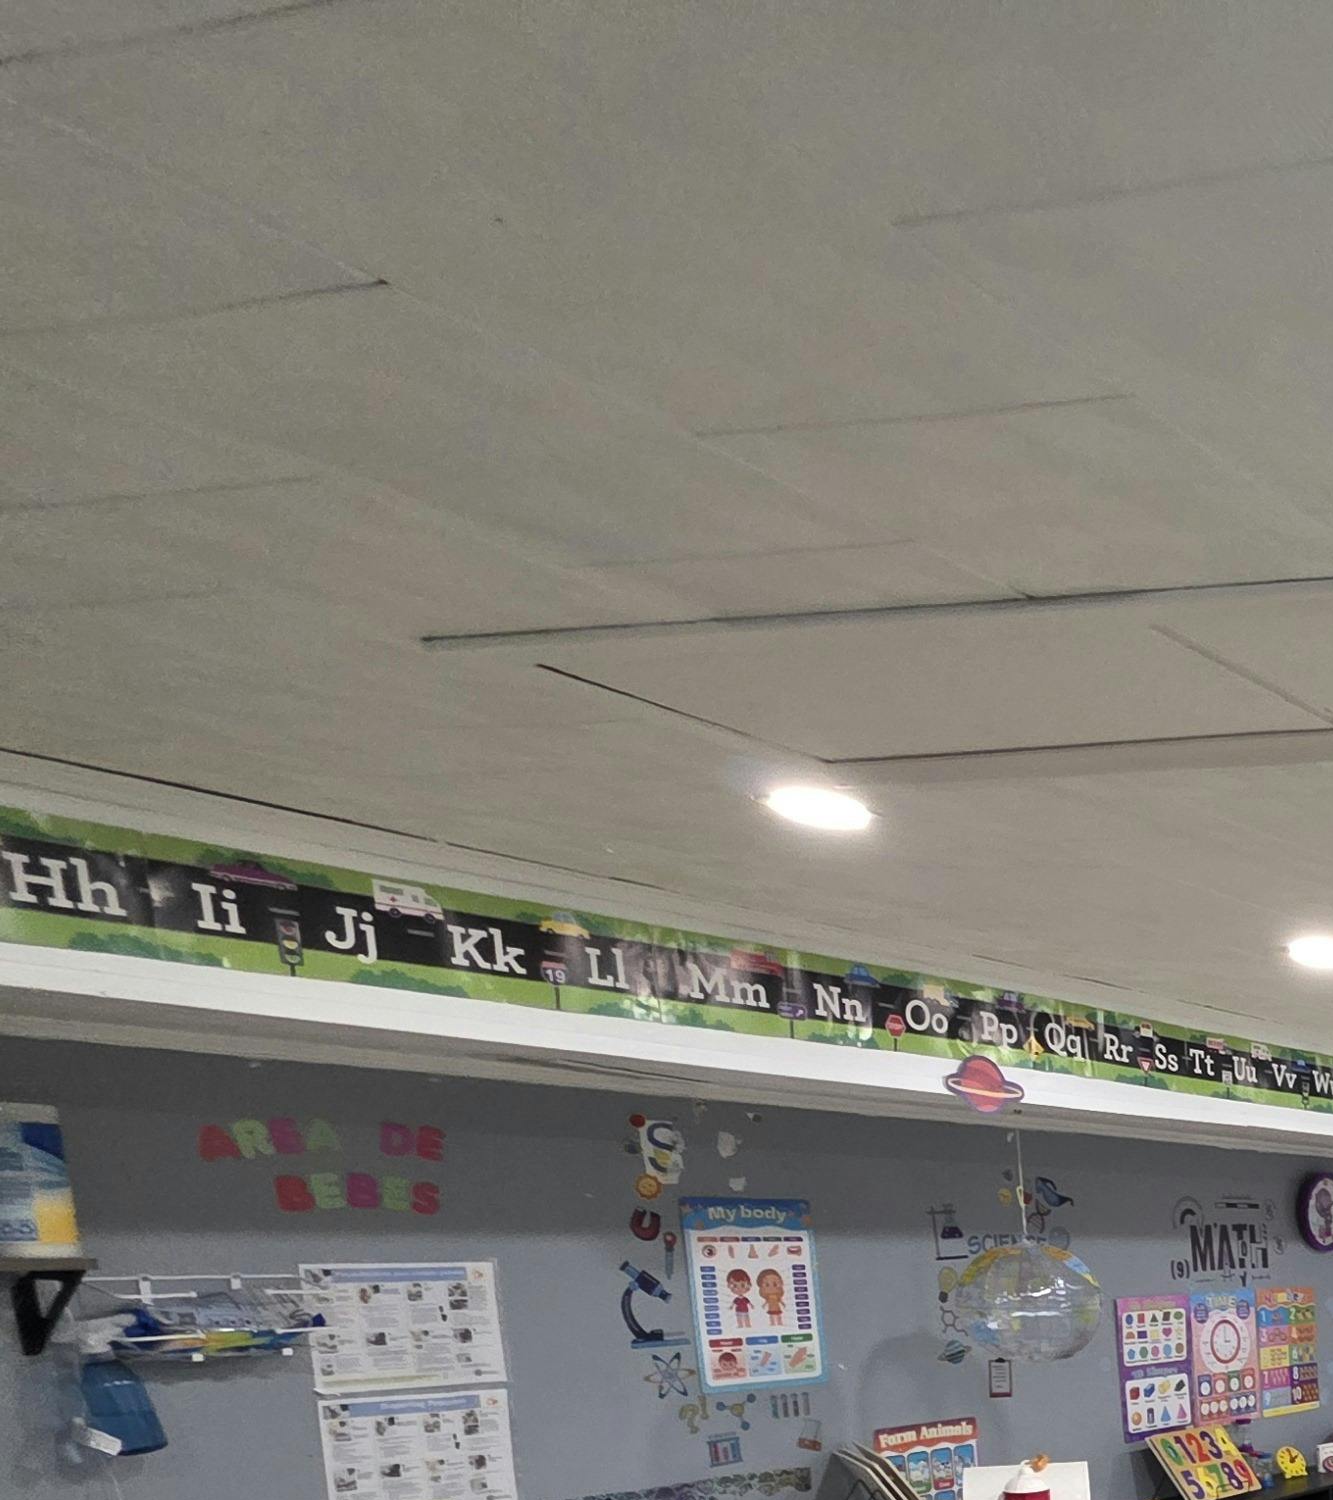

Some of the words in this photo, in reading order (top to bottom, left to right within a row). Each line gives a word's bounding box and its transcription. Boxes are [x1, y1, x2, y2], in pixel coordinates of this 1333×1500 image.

[1, 851, 128, 917] Hh
[191, 881, 247, 935] Ii
[325, 906, 378, 965] Jj
[448, 923, 527, 976] Kk
[585, 945, 627, 991] Ll
[688, 964, 769, 1008] Mm
[814, 983, 867, 1023] Nn
[905, 999, 949, 1035] Oo
[981, 1010, 1019, 1048] Pp
[1044, 1022, 1085, 1060] Qq
[1104, 1032, 1134, 1064] Rr
[1155, 1043, 1179, 1073] Ss
[1189, 1050, 1214, 1077] Tt
[1233, 1056, 1258, 1083] Uu
[1272, 1063, 1297, 1090] Vv
[545, 967, 566, 984] 19
[708, 1206, 737, 1222] My
[741, 1205, 786, 1222] body
[1190, 1224, 1269, 1272] MATH
[920, 1421, 973, 1441] Animals
[1173, 1436, 1196, 1464] 1
[1185, 1432, 1211, 1462] 2
[1199, 1431, 1223, 1459] 3
[1182, 1470, 1205, 1500] 5
[1220, 1462, 1244, 1490] 8
